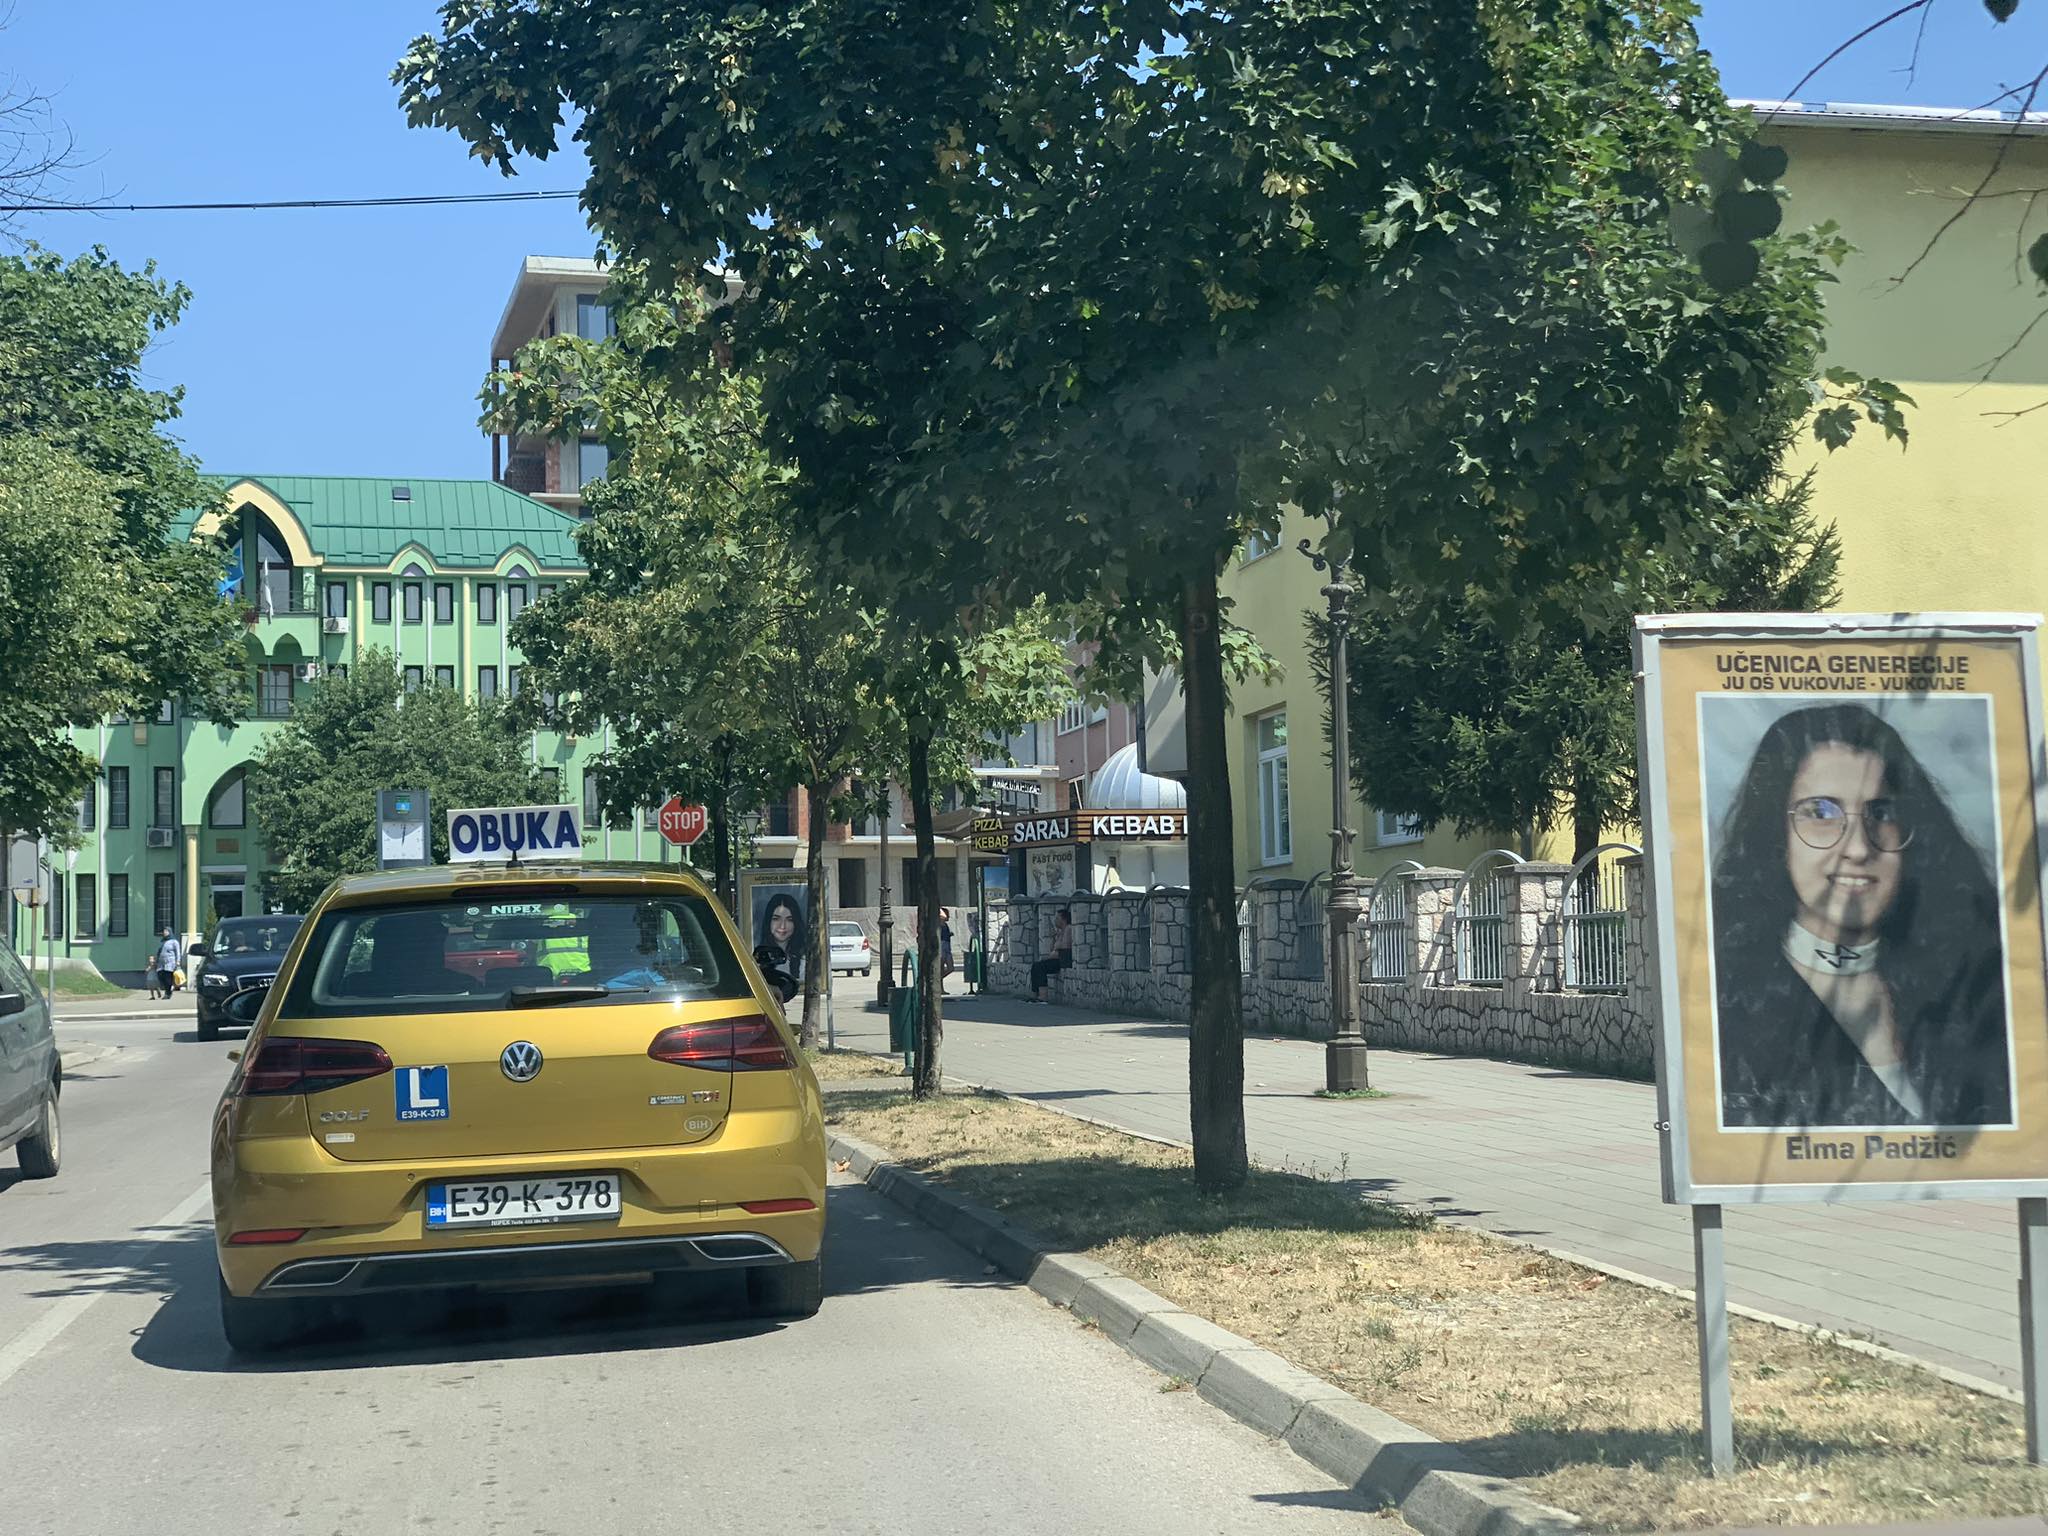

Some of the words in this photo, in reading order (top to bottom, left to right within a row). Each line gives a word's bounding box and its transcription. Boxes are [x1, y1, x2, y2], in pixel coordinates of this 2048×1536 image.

[1716, 651, 1821, 674] UČENICA
[1828, 655, 1969, 674] GENERECIJE
[1722, 677, 1745, 690] JU
[1749, 672, 1774, 690] OŠ
[1779, 676, 1867, 690] VUKOVIJE
[1880, 676, 1966, 691] VUKOVIJE
[662, 811, 702, 830] STOP
[974, 818, 1003, 832] PIZZA
[1093, 815, 1176, 835] KEBAB
[451, 810, 580, 854] OBUKA
[1014, 818, 1070, 843] SARAJ
[975, 835, 1009, 849] KEBAB
[1032, 853, 1051, 864] FAST
[1052, 852, 1073, 862] FOOD
[491, 903, 542, 915] NIPEX
[409, 1068, 440, 1108] L
[320, 1109, 369, 1122] GOLF
[402, 1109, 446, 1119] E39-K-378
[1786, 1136, 1855, 1160] Elma
[1864, 1135, 1957, 1160] Padžić
[450, 1180, 612, 1218] E39-K-378
